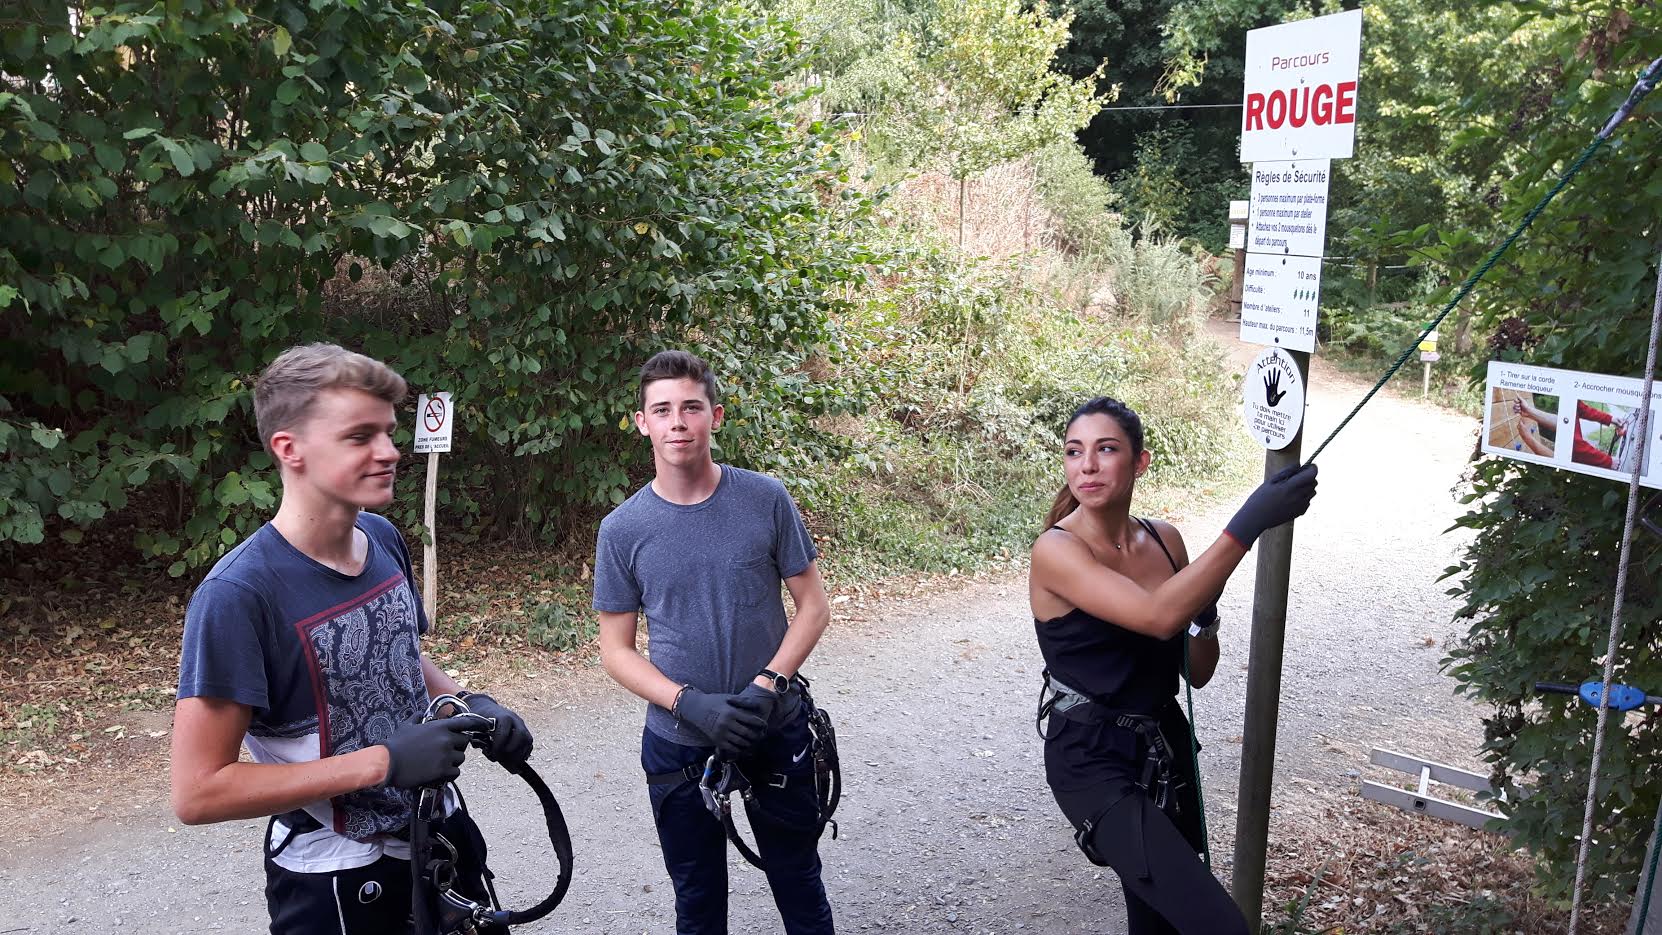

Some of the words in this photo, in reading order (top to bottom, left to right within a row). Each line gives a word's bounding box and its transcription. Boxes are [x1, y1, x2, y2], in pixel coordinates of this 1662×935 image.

[1272, 52, 1329, 70] Parcours
[1246, 81, 1356, 131] ROUGE
[1256, 171, 1280, 186] Règles
[1283, 171, 1291, 182] de
[1294, 170, 1325, 182] Sécurité
[1261, 196, 1278, 204] personnes
[1280, 193, 1296, 202] maximum
[1260, 210, 1275, 219] personne
[1276, 208, 1293, 217] maximum
[1301, 208, 1312, 218] atelier
[1256, 222, 1270, 231] Attachez
[1281, 224, 1305, 235] mousquetons
[1314, 224, 1317, 234] le
[1267, 236, 1271, 246] du
[1298, 271, 1304, 279] 10
[1244, 302, 1259, 310] Nombre
[1304, 309, 1309, 317] 11
[1243, 319, 1258, 327] Hauteur
[1276, 325, 1294, 333] parcours
[1300, 326, 1313, 336] 11,5m
[1257, 356, 1295, 384] Attention
[1507, 371, 1520, 380] Tirer
[1539, 376, 1555, 384] corde
[1500, 380, 1526, 389] Ramener
[1527, 382, 1552, 393] bloqueur
[1582, 382, 1613, 393] Accrocher
[1616, 388, 1661, 399] mousquons
[1260, 405, 1270, 414] dois
[1272, 410, 1291, 421] mettre
[1264, 414, 1277, 423] main
[1261, 427, 1285, 439] parcours
[1267, 421, 1286, 433] utiliser
